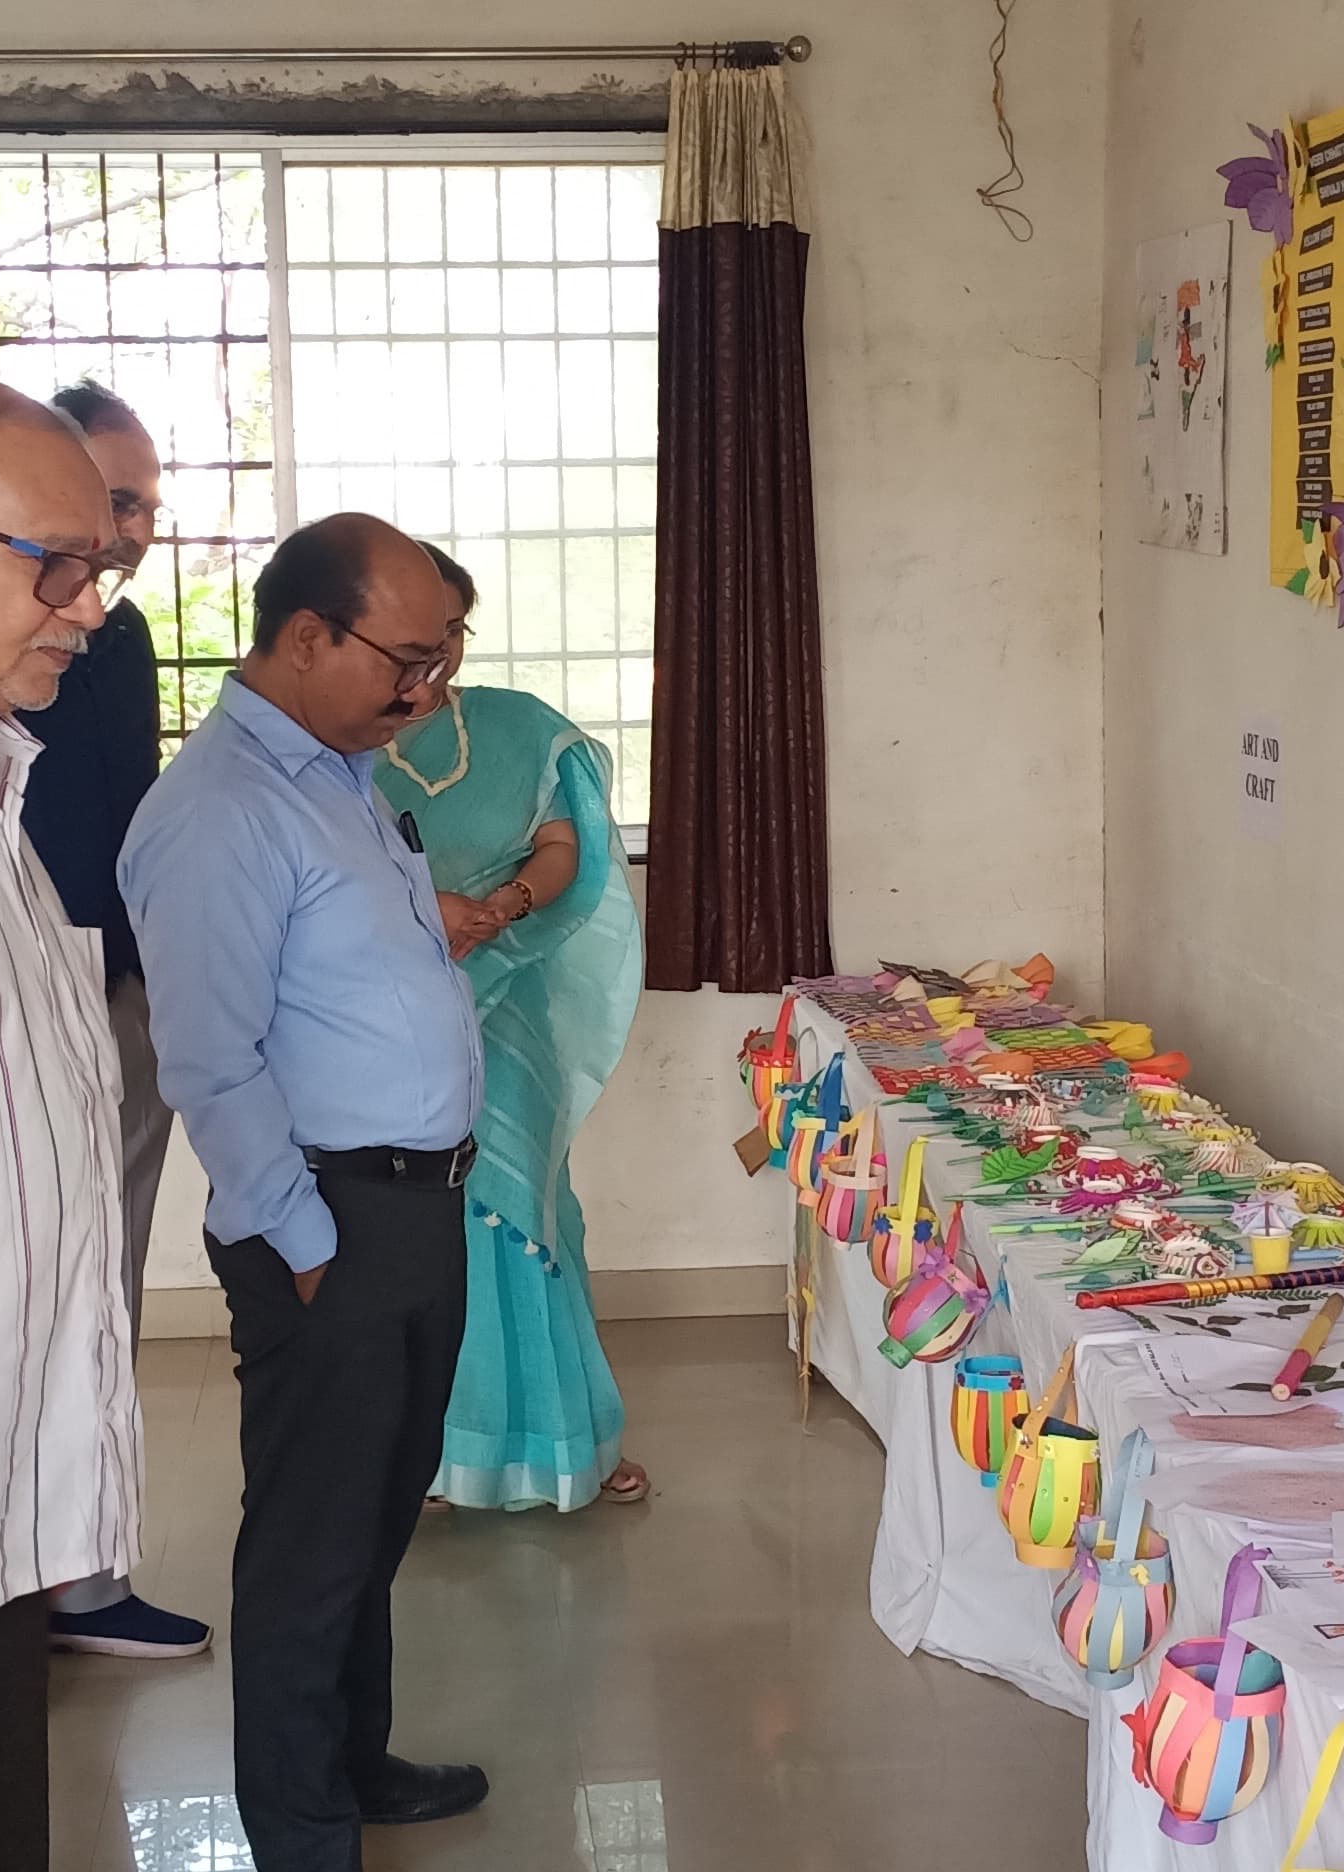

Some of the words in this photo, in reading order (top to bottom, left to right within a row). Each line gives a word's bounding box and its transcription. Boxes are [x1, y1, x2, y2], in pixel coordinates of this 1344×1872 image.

[1241, 733, 1259, 758] ART
[1261, 737, 1280, 762] AND
[1245, 773, 1275, 803] CRAFT
